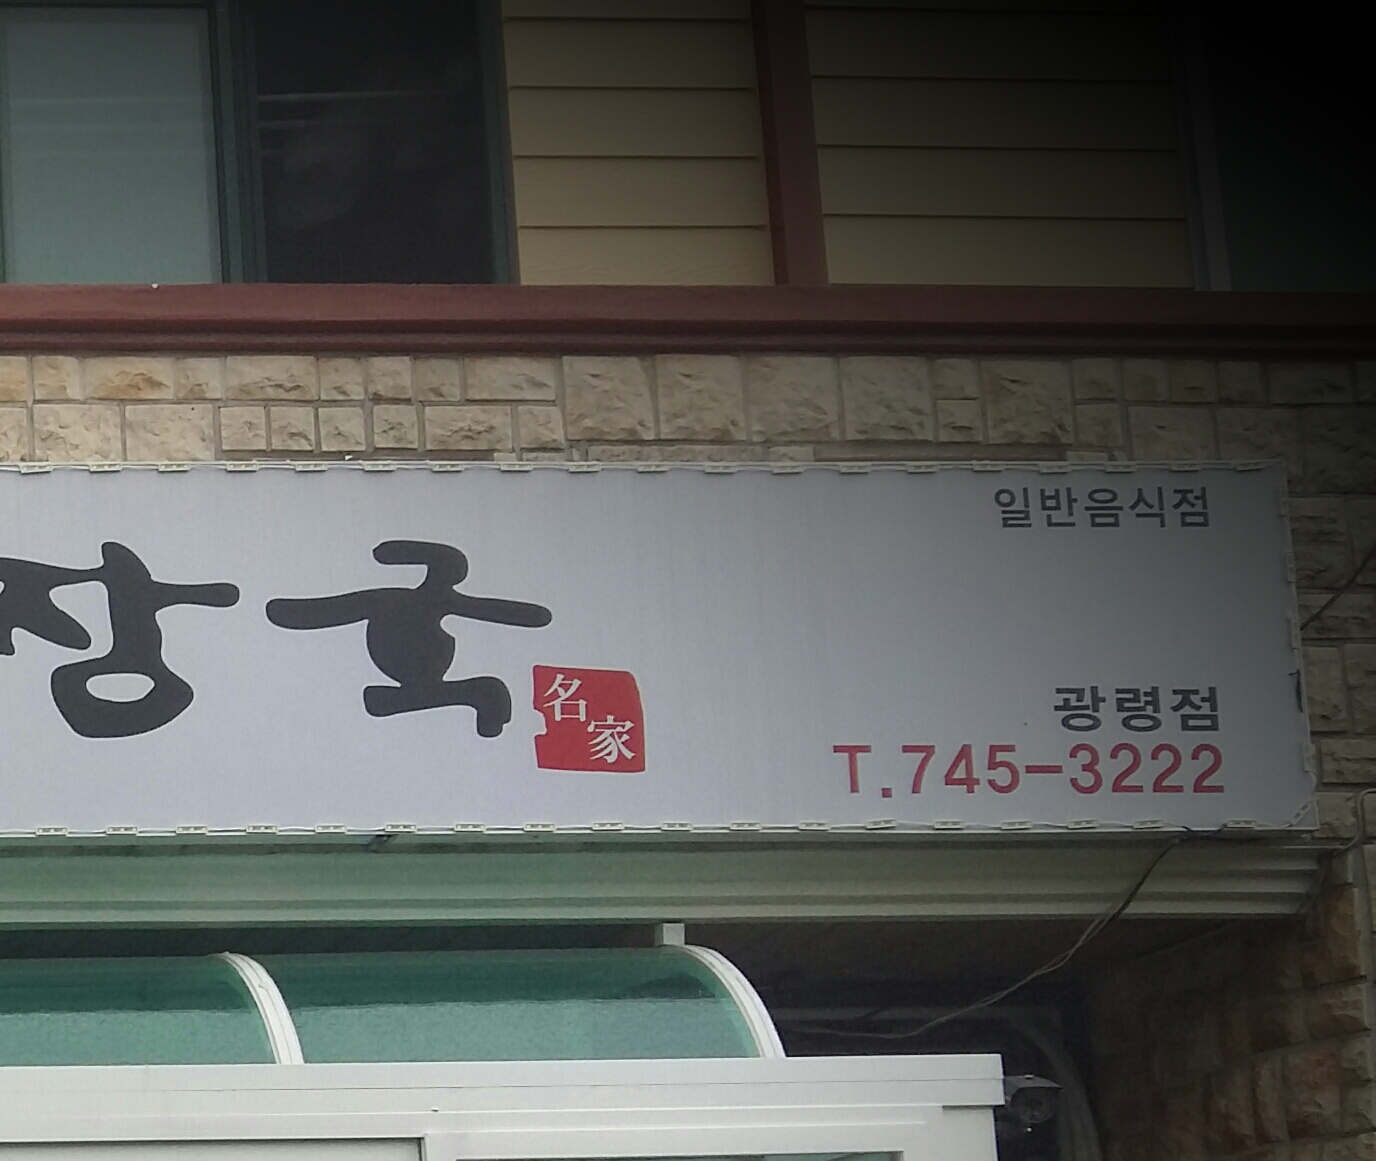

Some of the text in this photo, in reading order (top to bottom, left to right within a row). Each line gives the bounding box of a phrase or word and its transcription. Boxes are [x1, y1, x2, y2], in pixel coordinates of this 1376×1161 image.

[993, 486, 1211, 529] 일반음식점
[542, 672, 638, 764] 名家
[1053, 685, 1220, 732] 광령점
[832, 742, 1226, 799] T.745-3222
